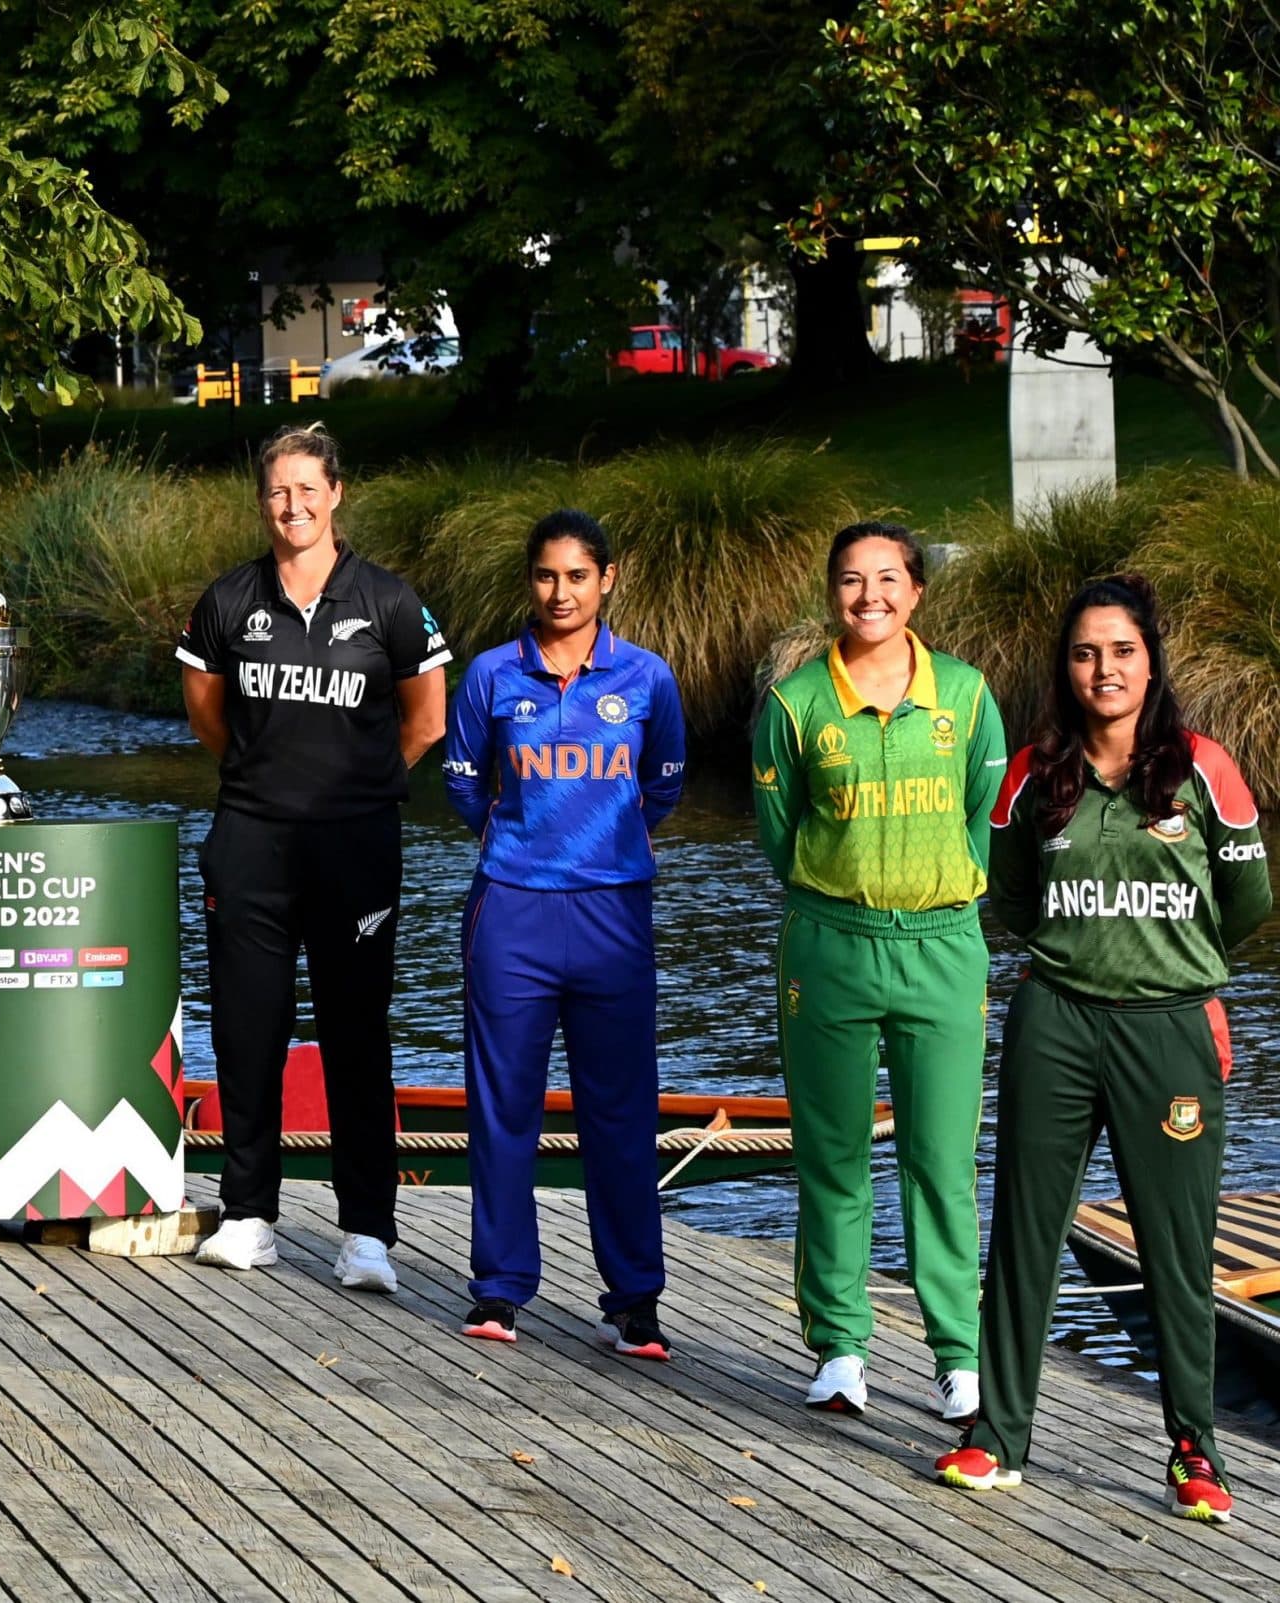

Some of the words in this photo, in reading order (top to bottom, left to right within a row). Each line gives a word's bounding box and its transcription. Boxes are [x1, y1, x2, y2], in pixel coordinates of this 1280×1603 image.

[239, 661, 275, 698] NEW
[279, 663, 366, 708] ZEALAND
[43, 877, 96, 899] CUP
[1043, 879, 1198, 920] ANGLADESH
[23, 906, 80, 926] 2022
[50, 975, 73, 984] FTX
